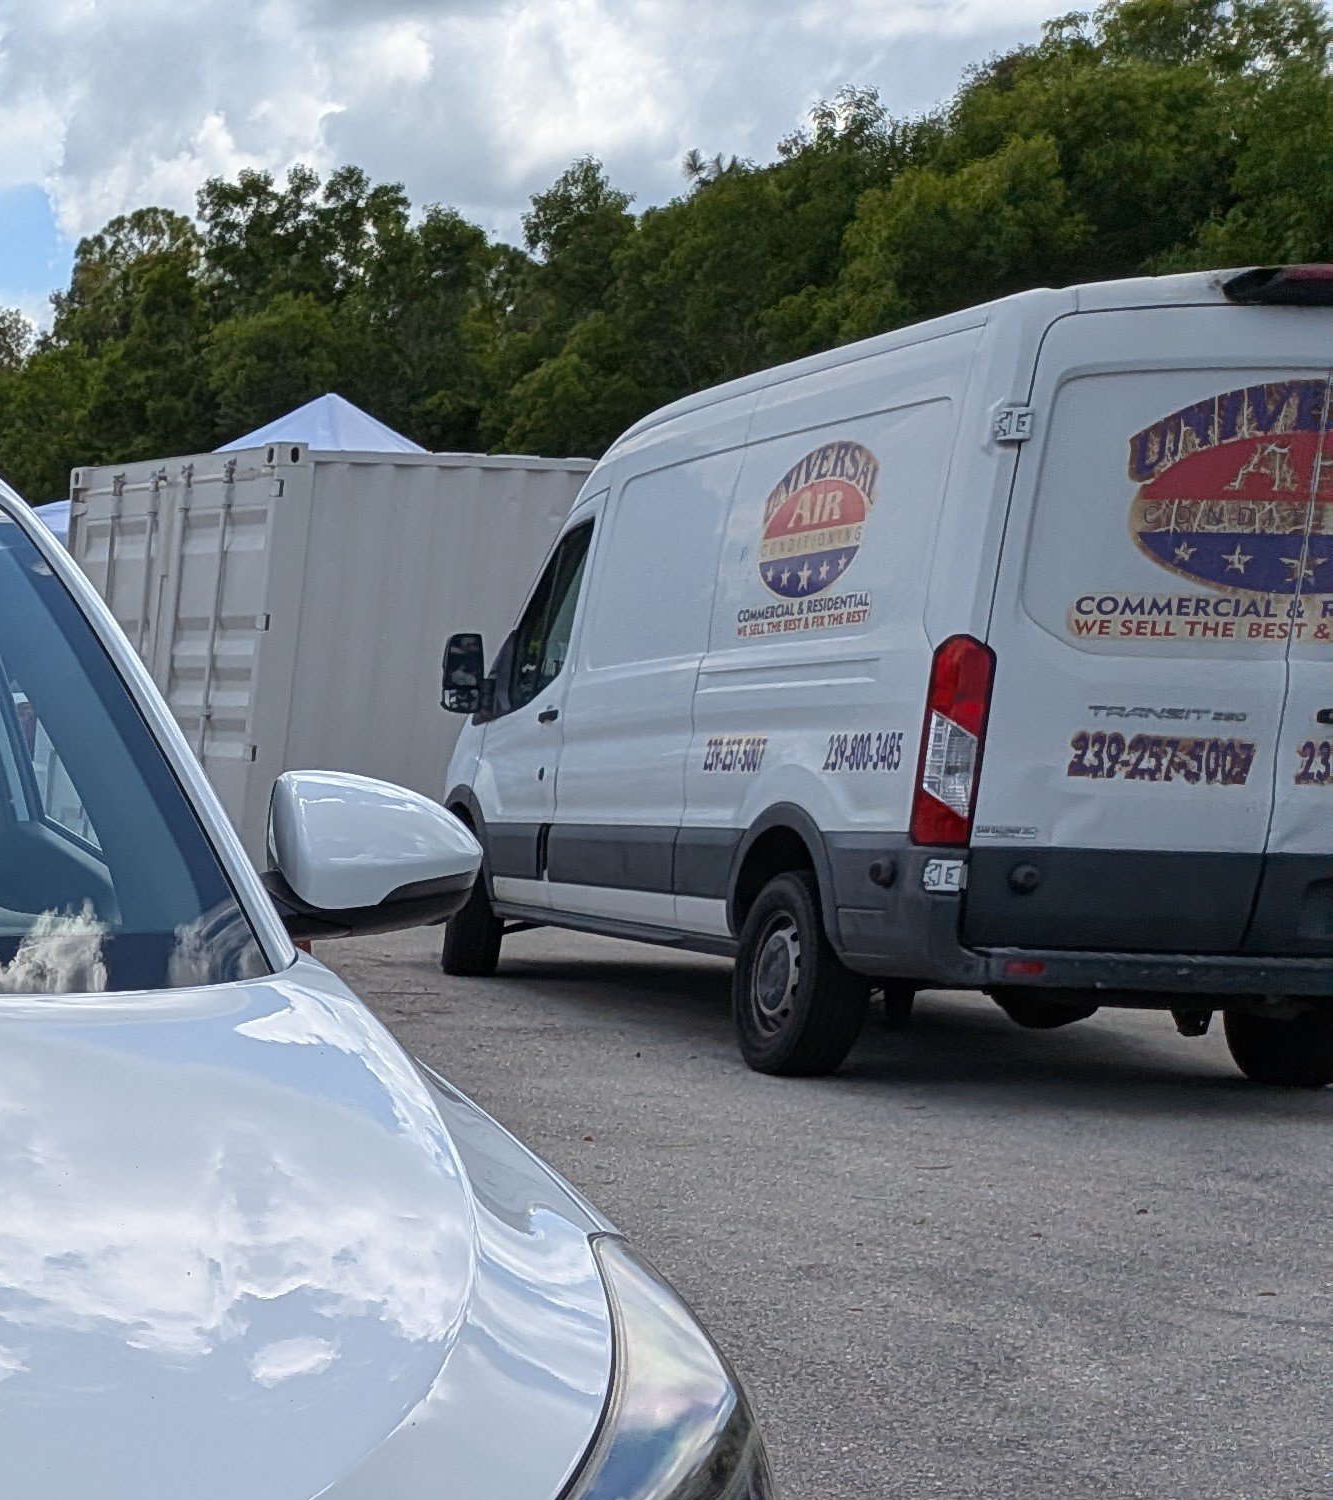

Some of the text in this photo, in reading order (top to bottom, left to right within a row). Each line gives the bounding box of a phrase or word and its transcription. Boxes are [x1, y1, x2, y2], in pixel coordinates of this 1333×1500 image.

[763, 441, 879, 525] UNIVERSAL
[787, 490, 843, 529] AIR
[738, 593, 870, 623] COMMERCIAL & RESIDENTIAL
[1075, 596, 1278, 618] COMMERCIAL
[1286, 599, 1305, 619] &
[737, 609, 868, 636] WE SELL THE BEST & FIX THE REST
[1074, 619, 1331, 640] WE SELL THE BEST &
[1088, 705, 1211, 721] TRANSIT
[703, 732, 904, 772] 239-257-5007 239-800-3485
